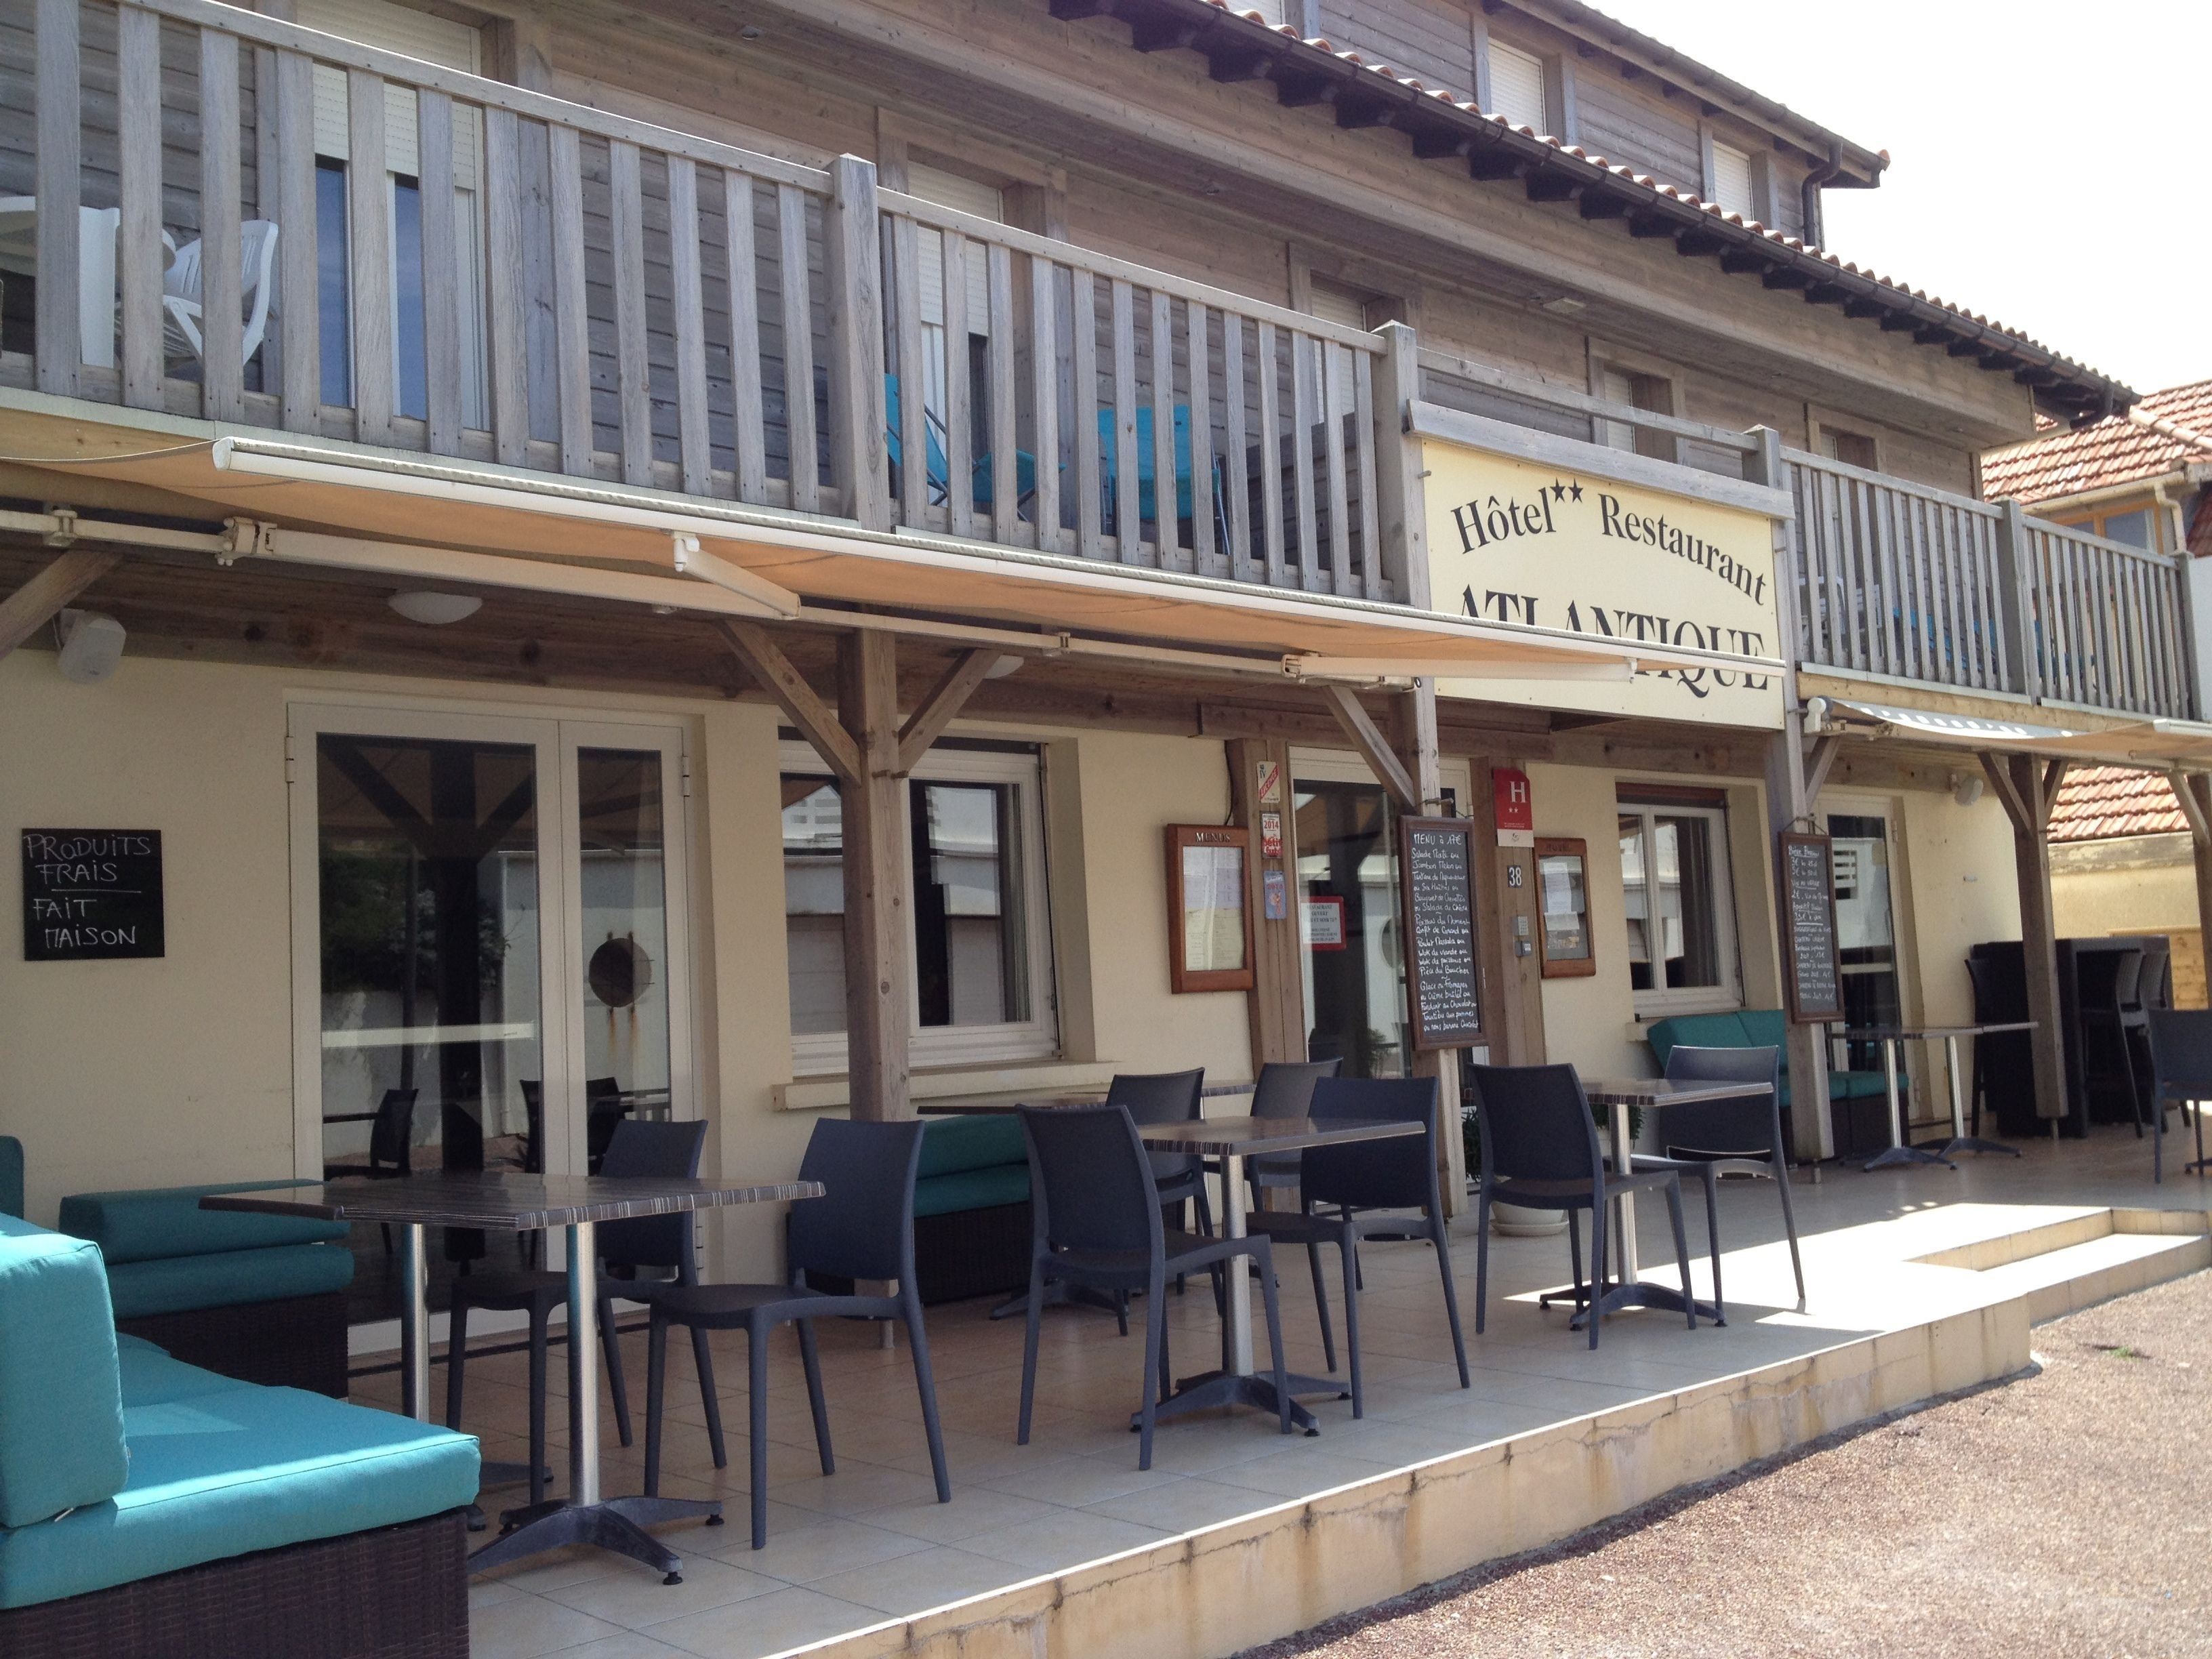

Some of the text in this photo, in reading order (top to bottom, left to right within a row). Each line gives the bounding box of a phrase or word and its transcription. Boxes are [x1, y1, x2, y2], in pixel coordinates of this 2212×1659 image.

[1451, 487, 1766, 606] Hôtel Restaurant
[1510, 781, 1527, 803] H
[1264, 821, 1279, 830] 2014
[1195, 832, 1231, 842] MENUS
[1414, 834, 1435, 845] MENU
[35, 860, 117, 884] FRAIS
[1509, 867, 1522, 886] 38
[33, 897, 97, 920] FAIT
[45, 924, 136, 948] MAISON
